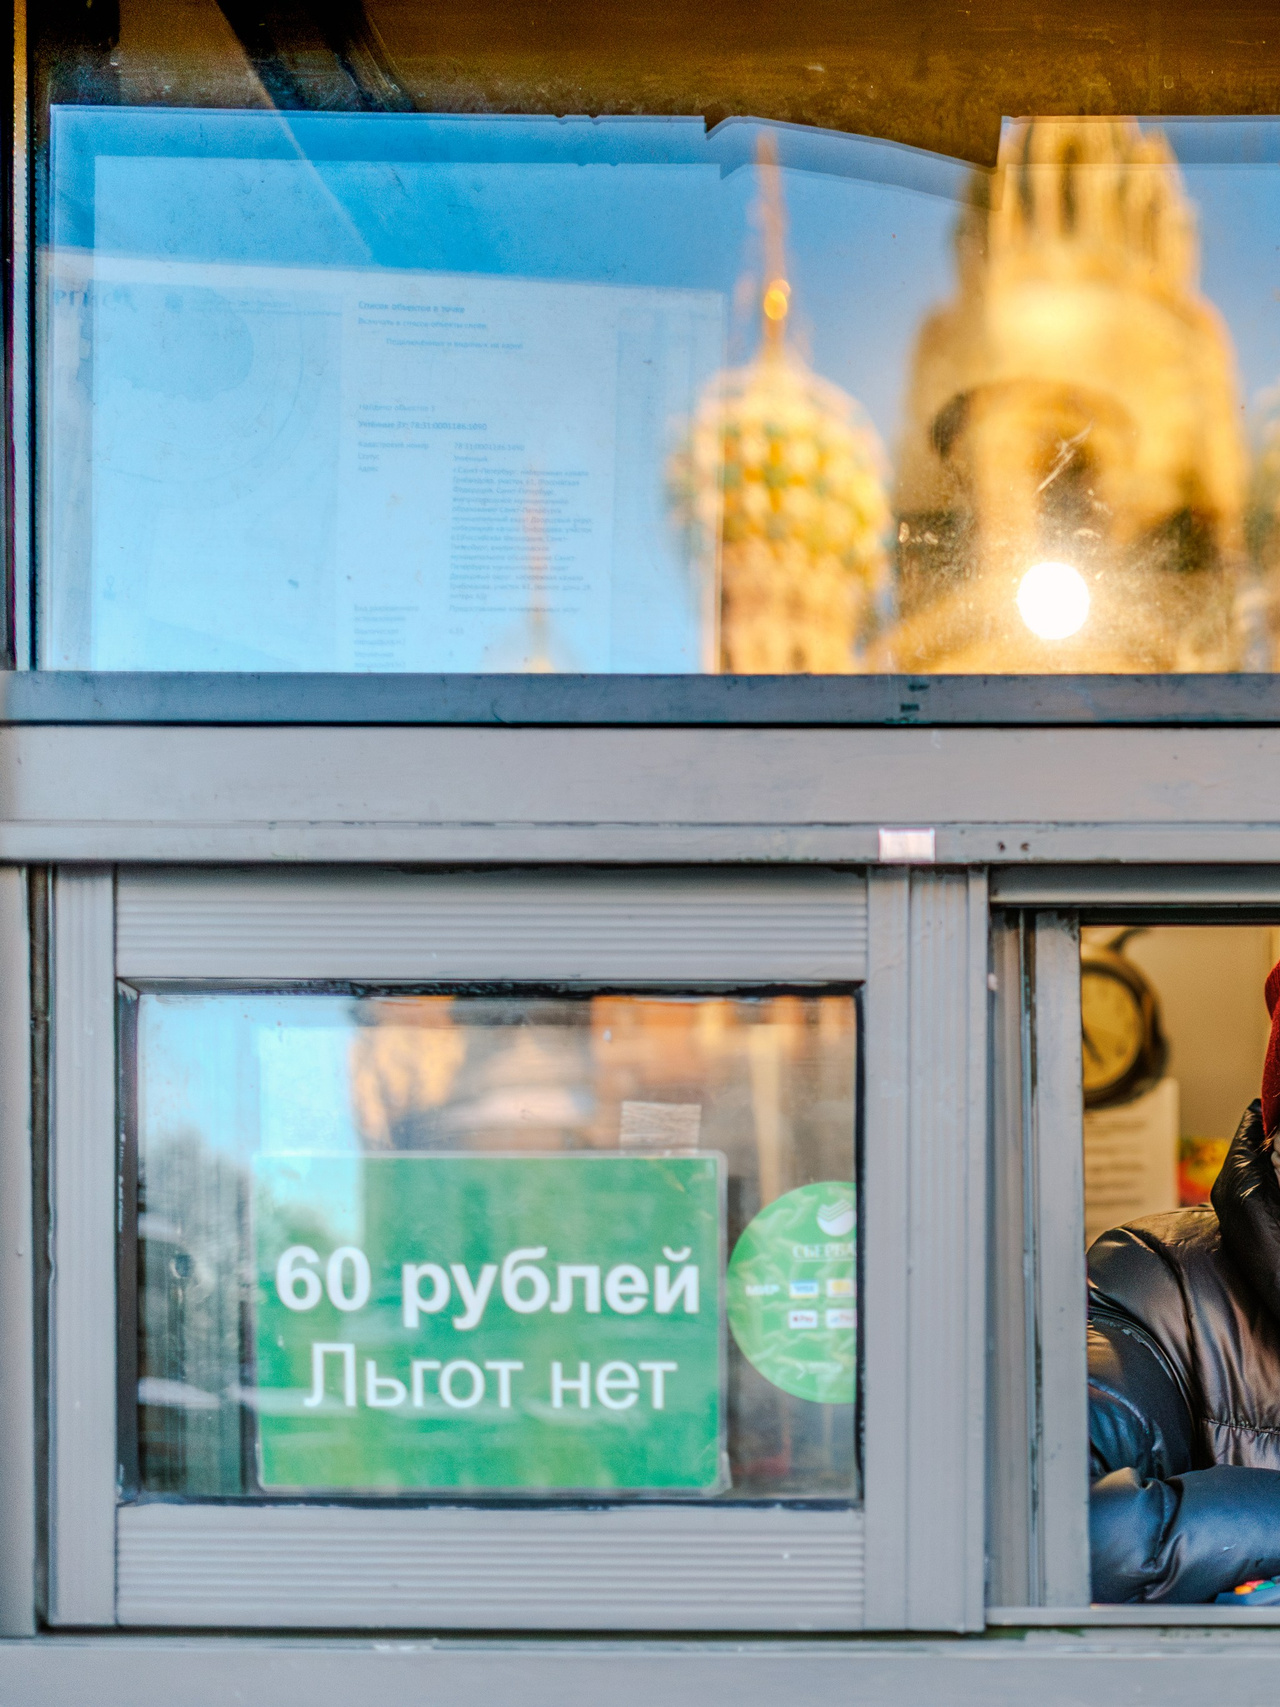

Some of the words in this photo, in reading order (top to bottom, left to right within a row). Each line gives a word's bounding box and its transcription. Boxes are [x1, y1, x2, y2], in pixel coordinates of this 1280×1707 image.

[275, 1244, 372, 1312] 60
[401, 1245, 700, 1332] рублей
[302, 1341, 524, 1409] Льгот
[551, 1361, 679, 1411] нет
